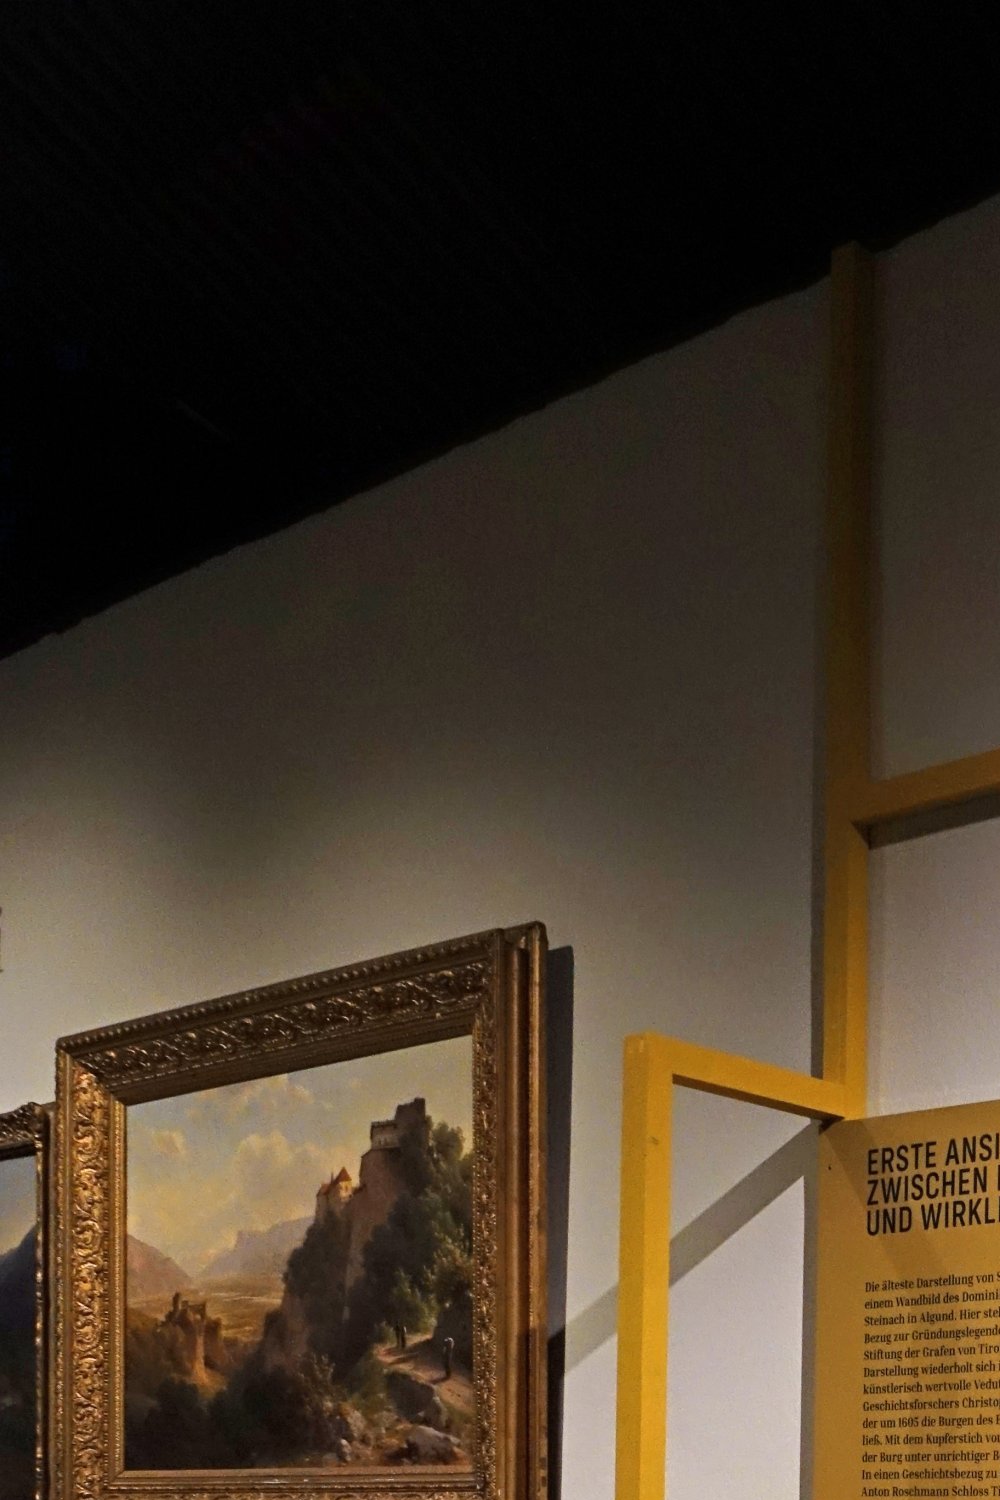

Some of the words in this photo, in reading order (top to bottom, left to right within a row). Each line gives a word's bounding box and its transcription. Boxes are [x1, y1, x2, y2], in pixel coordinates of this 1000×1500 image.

[867, 1141, 937, 1176] ERSTE
[867, 1166, 988, 1206] ZWISCHEN
[866, 1206, 912, 1236] UND
[865, 1280, 881, 1293] Die
[881, 1279, 915, 1292] älteste
[916, 1273, 974, 1289] Darstellung
[975, 1273, 995, 1284] von
[864, 1298, 894, 1310] einem
[895, 1292, 941, 1307] Wandbild
[942, 1291, 960, 1305] des
[863, 1332, 892, 1346] Bezug
[893, 1332, 910, 1342] zur
[863, 1364, 920, 1379] Darstellung
[920, 1361, 974, 1376] wiederholt
[975, 1359, 996, 1373] sich
[862, 1397, 960, 1412] Geschichtsforschers
[861, 1433, 883, 1447] ließ.
[884, 1433, 901, 1446] Mit
[902, 1433, 924, 1446] dem
[925, 1431, 983, 1448] Kupferstich
[861, 1450, 878, 1463] der
[879, 1451, 903, 1465] Burg
[904, 1452, 932, 1463] unter
[933, 1449, 991, 1465] unrichtiger
[861, 1469, 873, 1481] In
[873, 1468, 900, 1481] einen
[901, 1467, 984, 1482] Geschichtsbezug
[985, 1469, 998, 1480] zu
[860, 1486, 890, 1498] Anton
[892, 1485, 950, 1498] Roschmann
[951, 1484, 990, 1497] Schloss
